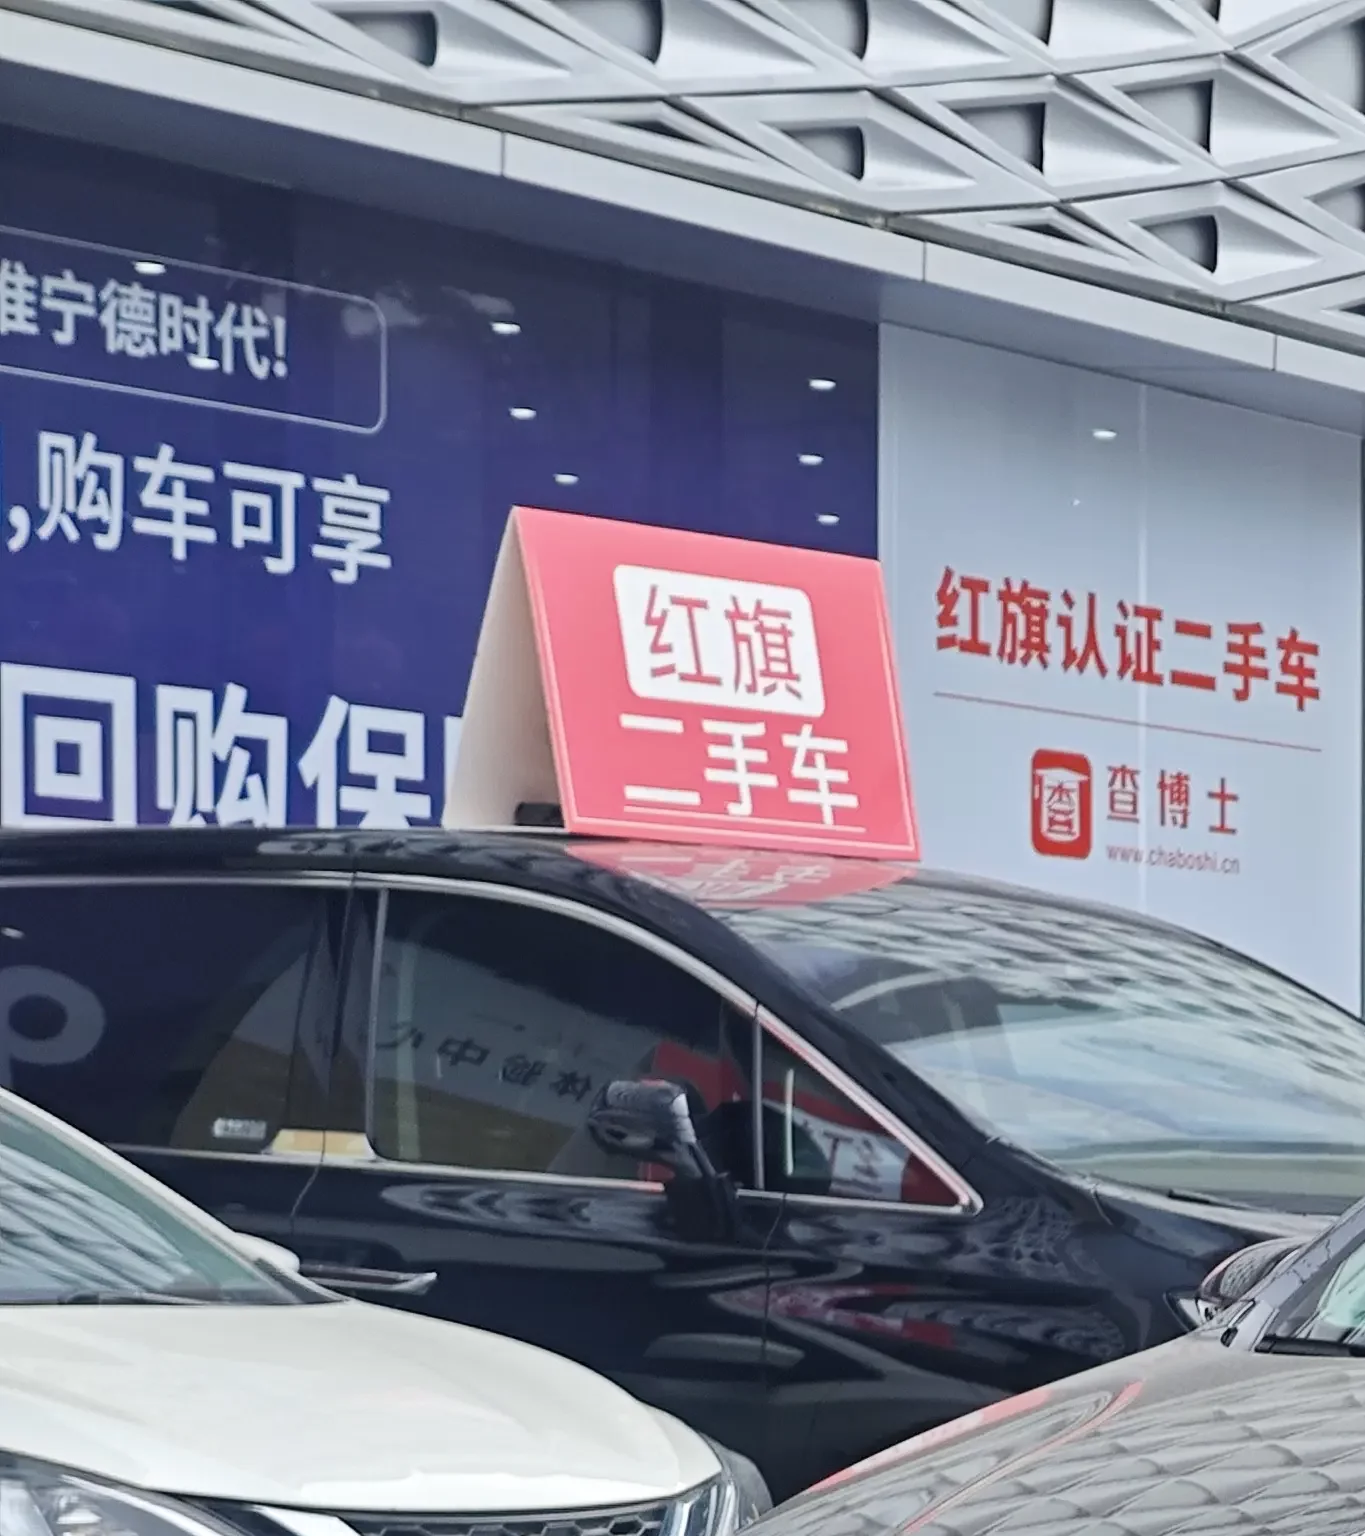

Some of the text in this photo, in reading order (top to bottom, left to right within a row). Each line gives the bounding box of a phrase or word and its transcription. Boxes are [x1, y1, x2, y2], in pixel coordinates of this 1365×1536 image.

[643, 583, 803, 701] 红旗
[936, 566, 1321, 711] 红旗认证二手车
[0, 661, 462, 829] 回购保
[620, 714, 860, 827] 二手车
[1106, 764, 1240, 836] 查博士
